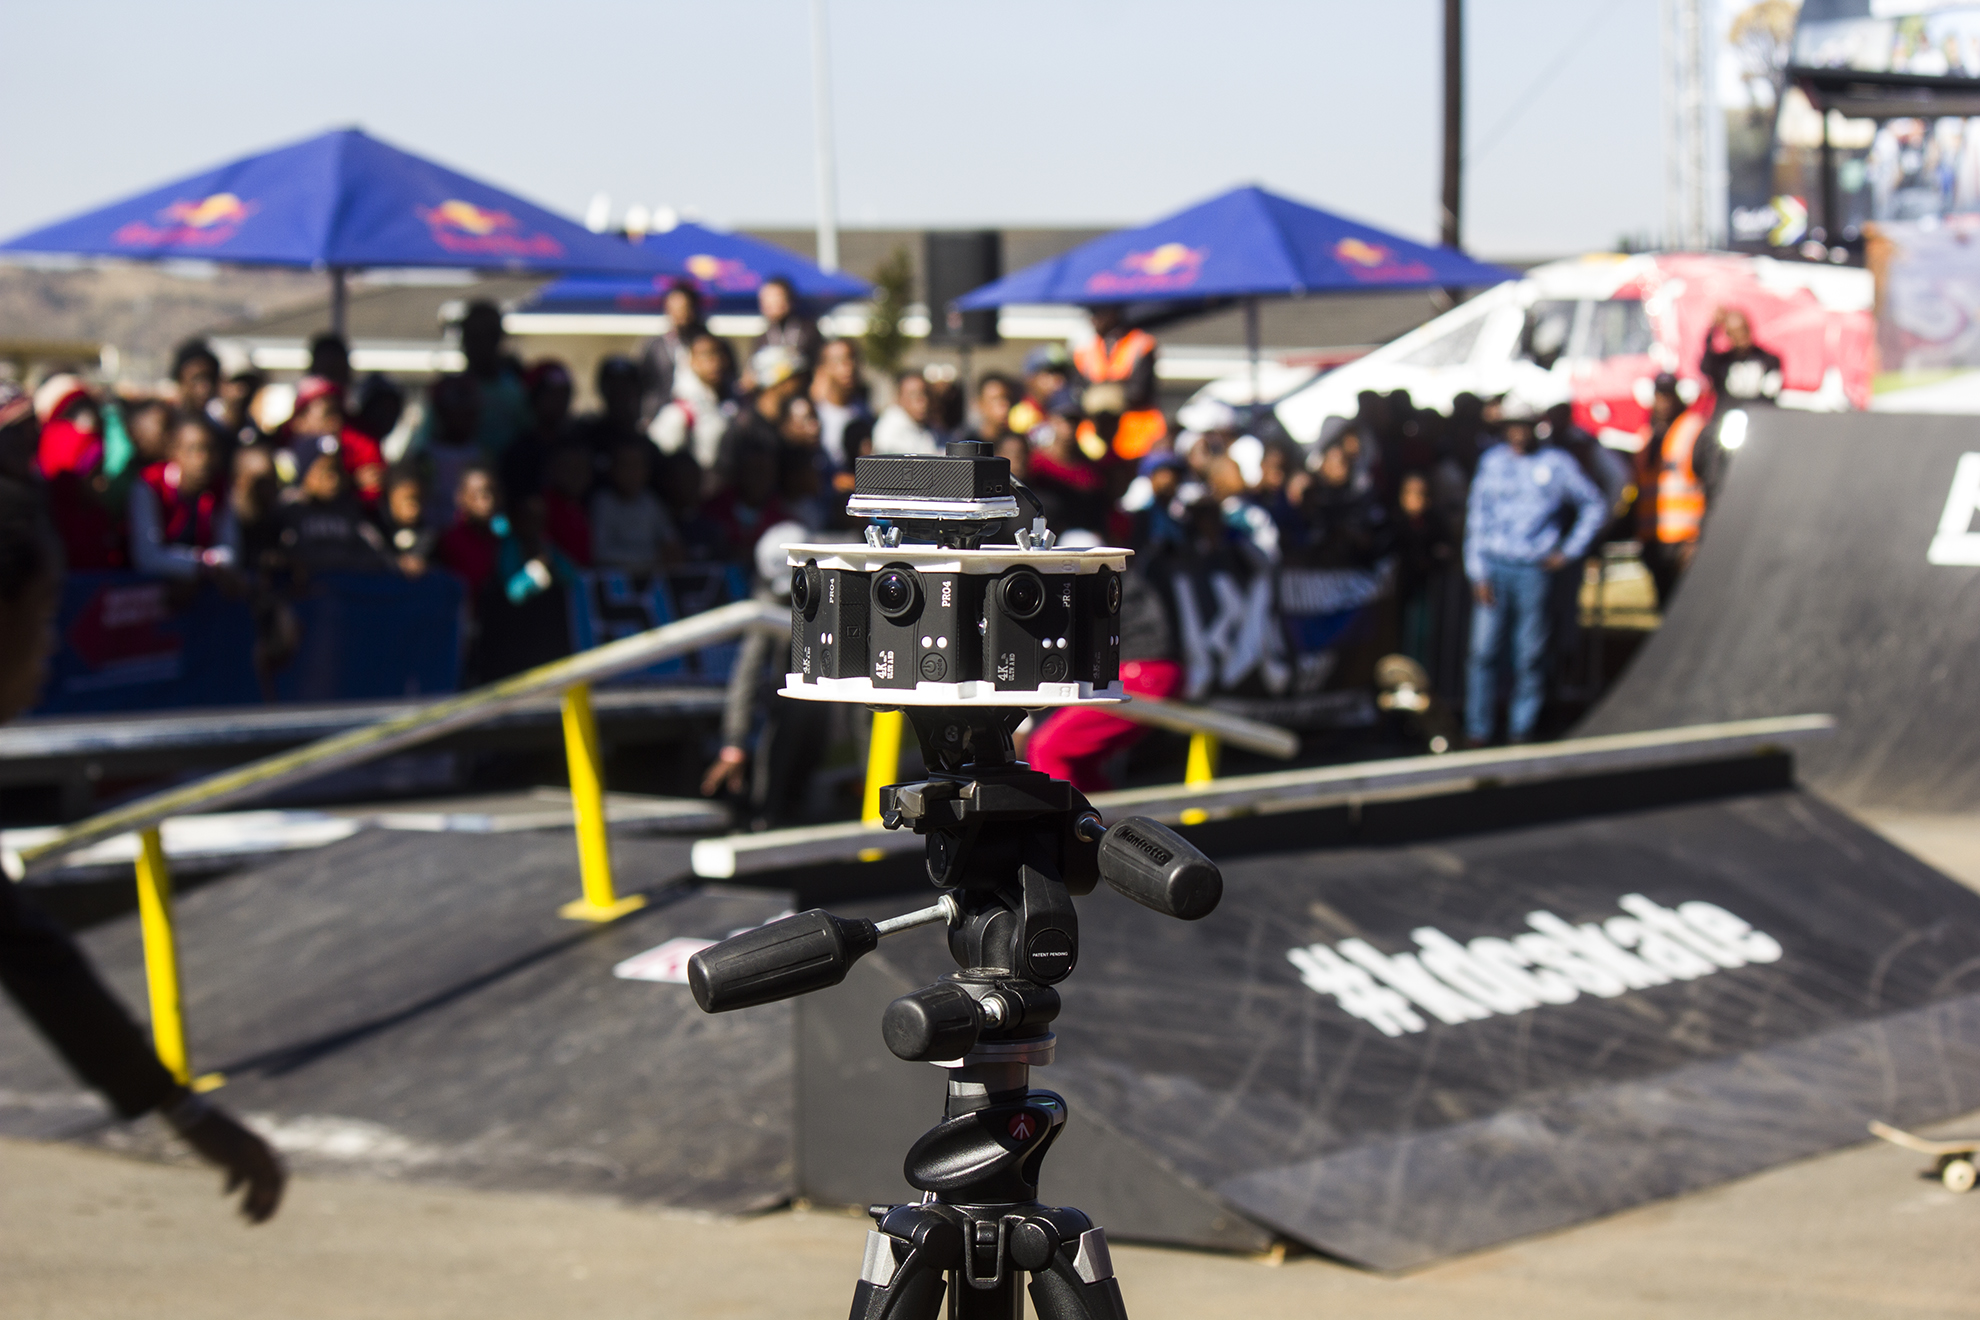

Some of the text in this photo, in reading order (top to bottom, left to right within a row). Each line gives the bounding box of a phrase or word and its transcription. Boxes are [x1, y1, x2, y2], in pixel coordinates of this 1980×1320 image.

[941, 581, 952, 608] PRO4
[1062, 582, 1072, 608] PRO4
[887, 650, 894, 659] HD
[1008, 653, 1016, 662] HD
[802, 658, 808, 674] 4K
[875, 662, 887, 680] 4K
[997, 665, 1009, 681] 4K
[1119, 828, 1168, 862] Manfrotto
